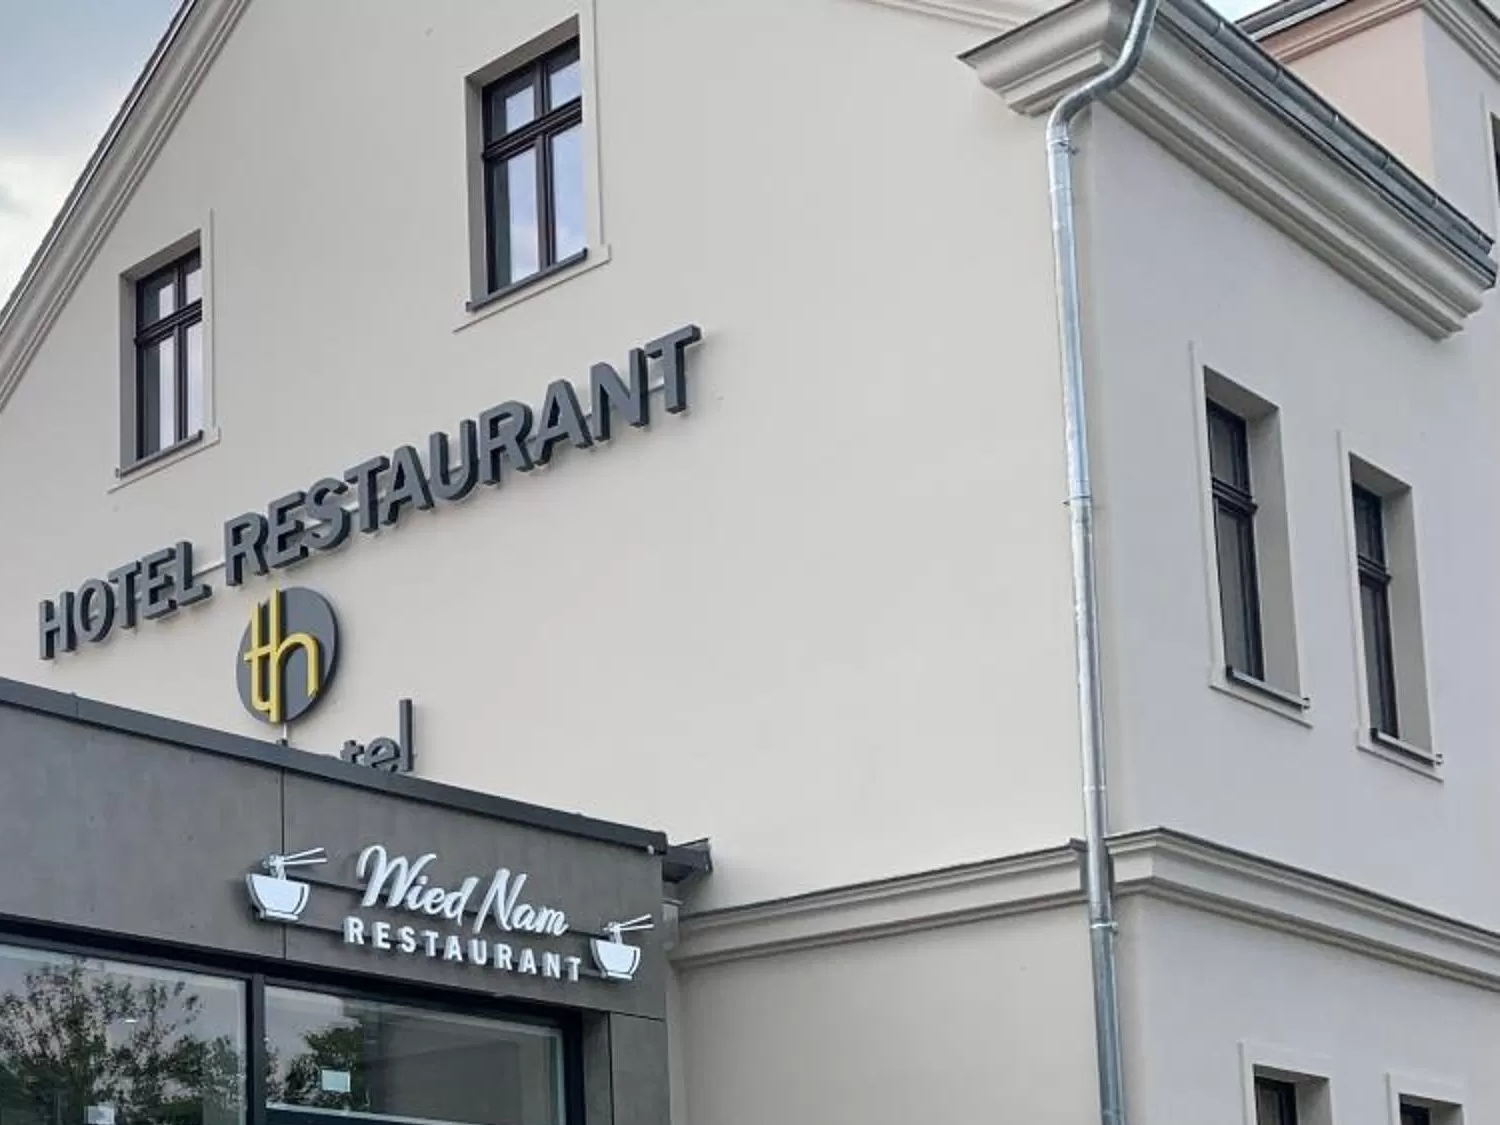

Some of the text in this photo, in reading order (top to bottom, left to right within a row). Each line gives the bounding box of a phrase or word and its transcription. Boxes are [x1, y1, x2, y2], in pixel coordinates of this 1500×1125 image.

[38, 324, 703, 661] HOTEL RESTAURANT
[357, 845, 570, 937] Wied Nam
[343, 916, 582, 982] RESTAURANT
